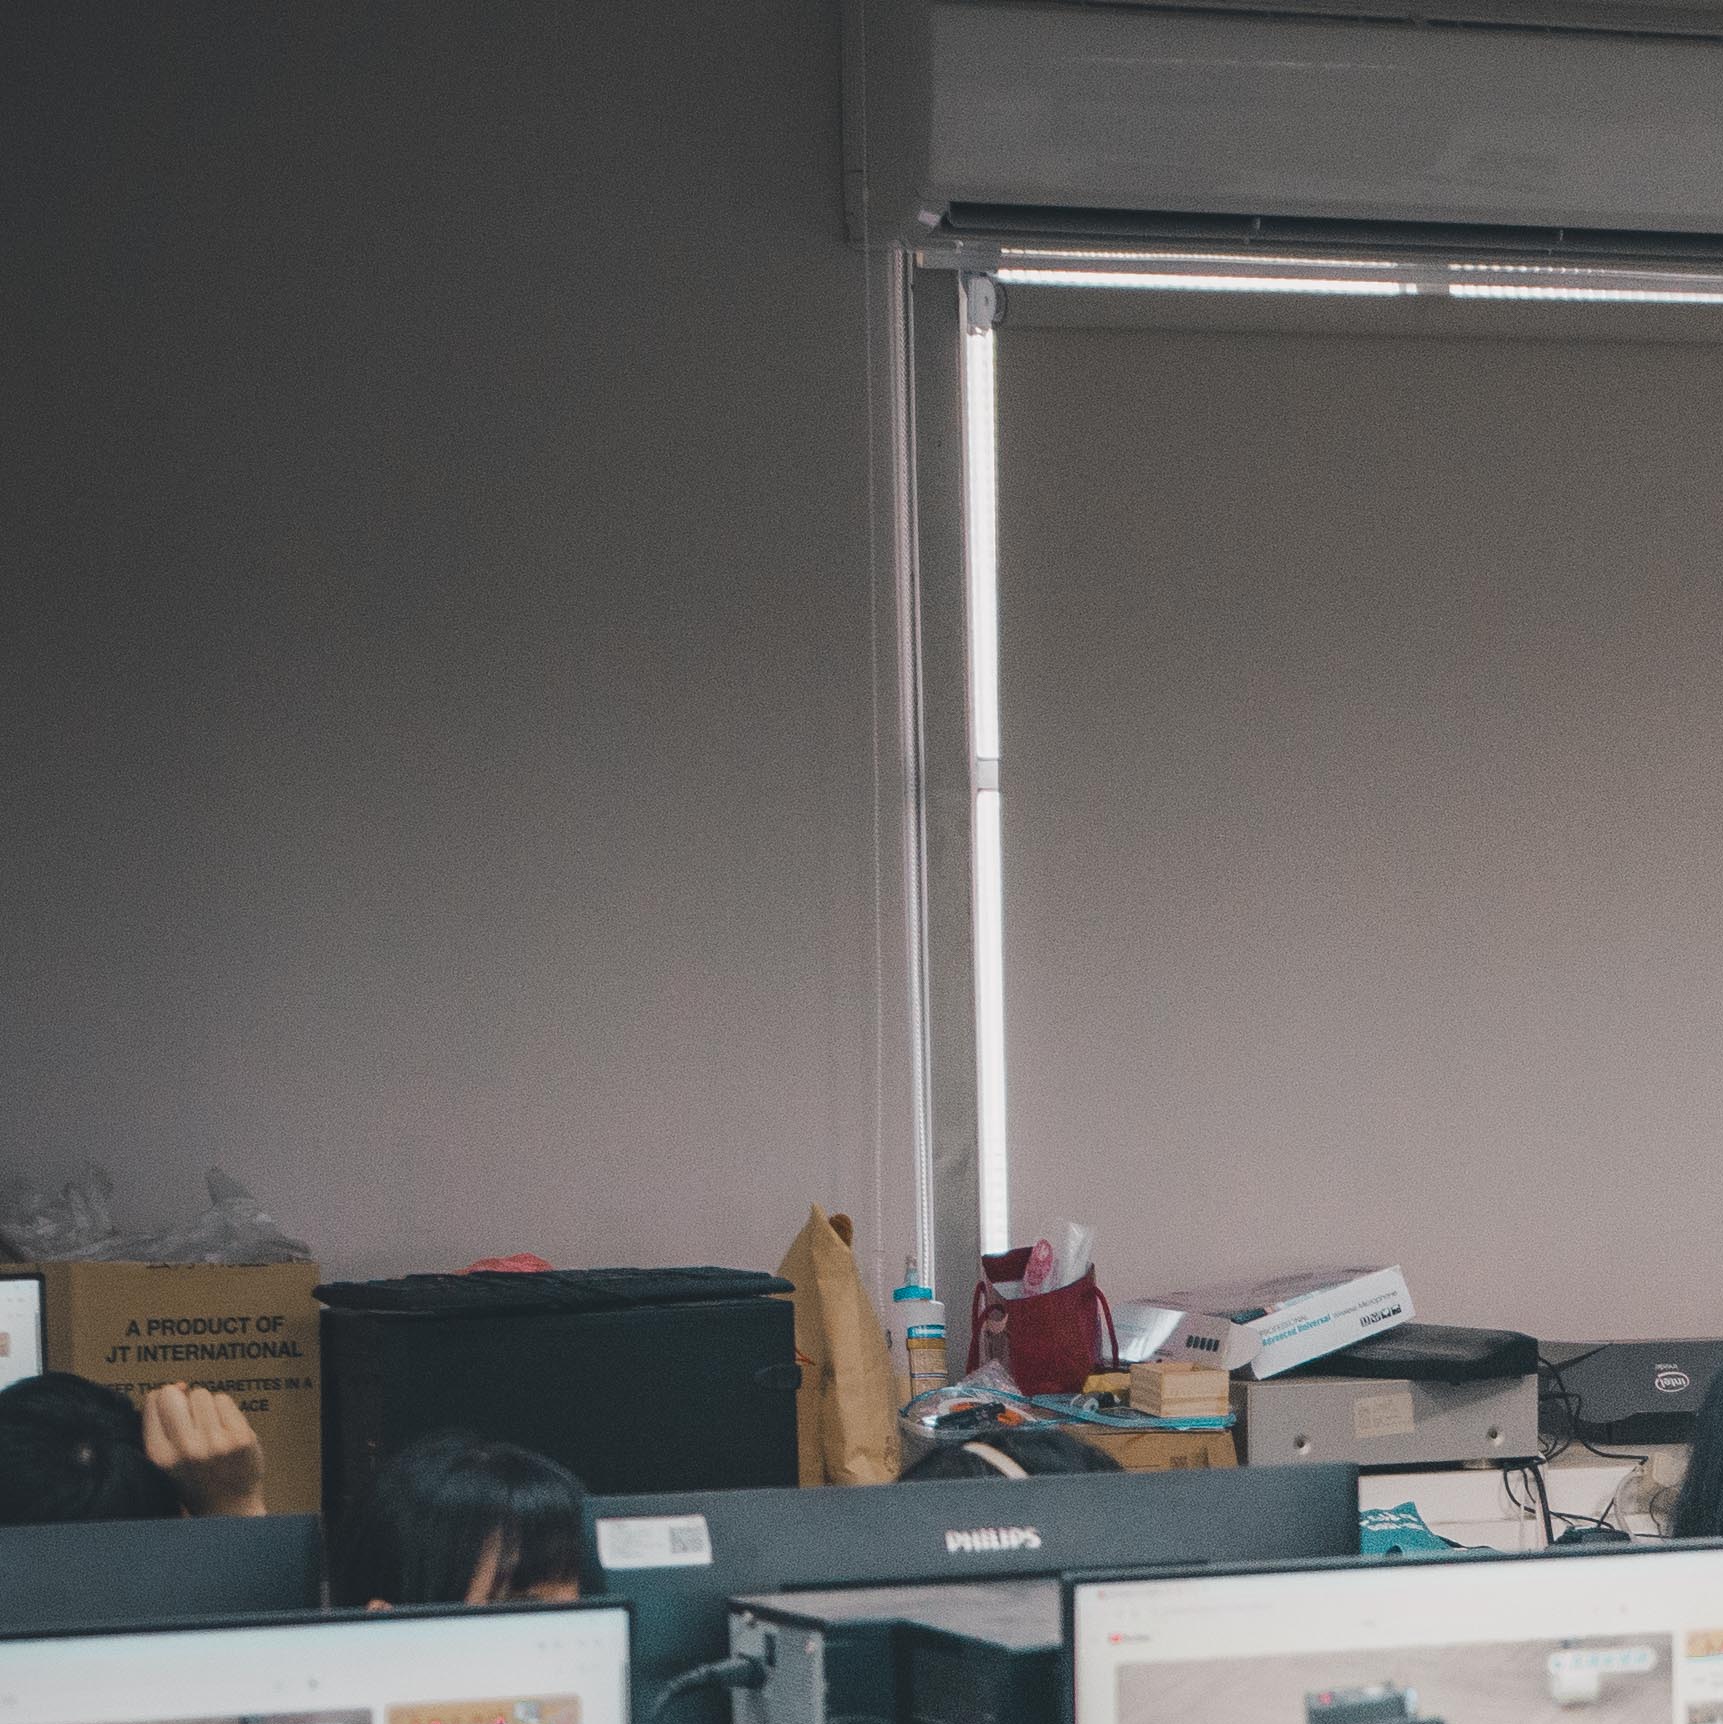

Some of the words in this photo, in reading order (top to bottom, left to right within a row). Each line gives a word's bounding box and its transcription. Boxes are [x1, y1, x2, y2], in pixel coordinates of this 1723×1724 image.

[126, 1319, 140, 1336] A
[148, 1316, 250, 1336] PRODUCT
[255, 1315, 286, 1333] OF
[105, 1345, 131, 1364] JT
[136, 1340, 303, 1363] INTERNATIONAL
[944, 1526, 1041, 1552] PHILIPS
